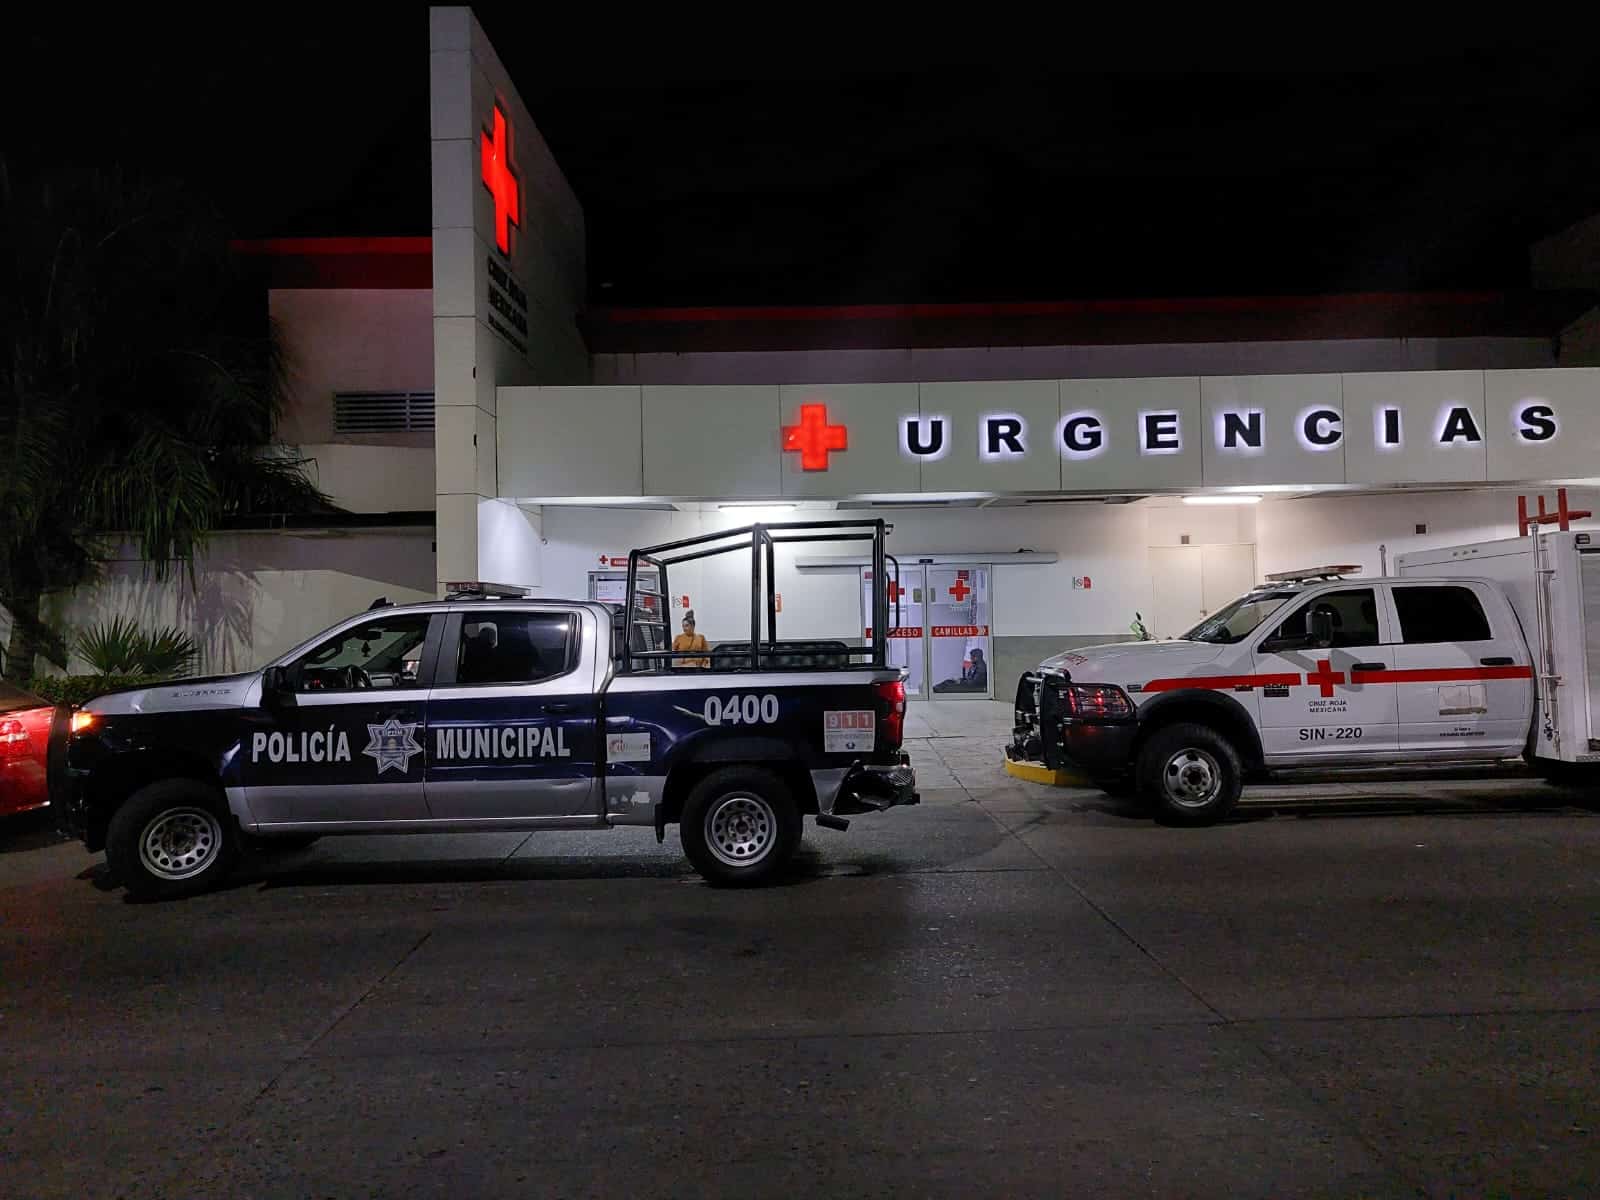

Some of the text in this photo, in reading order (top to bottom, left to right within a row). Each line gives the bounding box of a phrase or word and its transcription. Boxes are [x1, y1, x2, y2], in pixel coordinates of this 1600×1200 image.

[906, 405, 1557, 455] URGENCIAS
[934, 626, 973, 636] CAMILLAS
[252, 724, 352, 763] POLICÍA
[436, 727, 571, 759] MUNICIPAL
